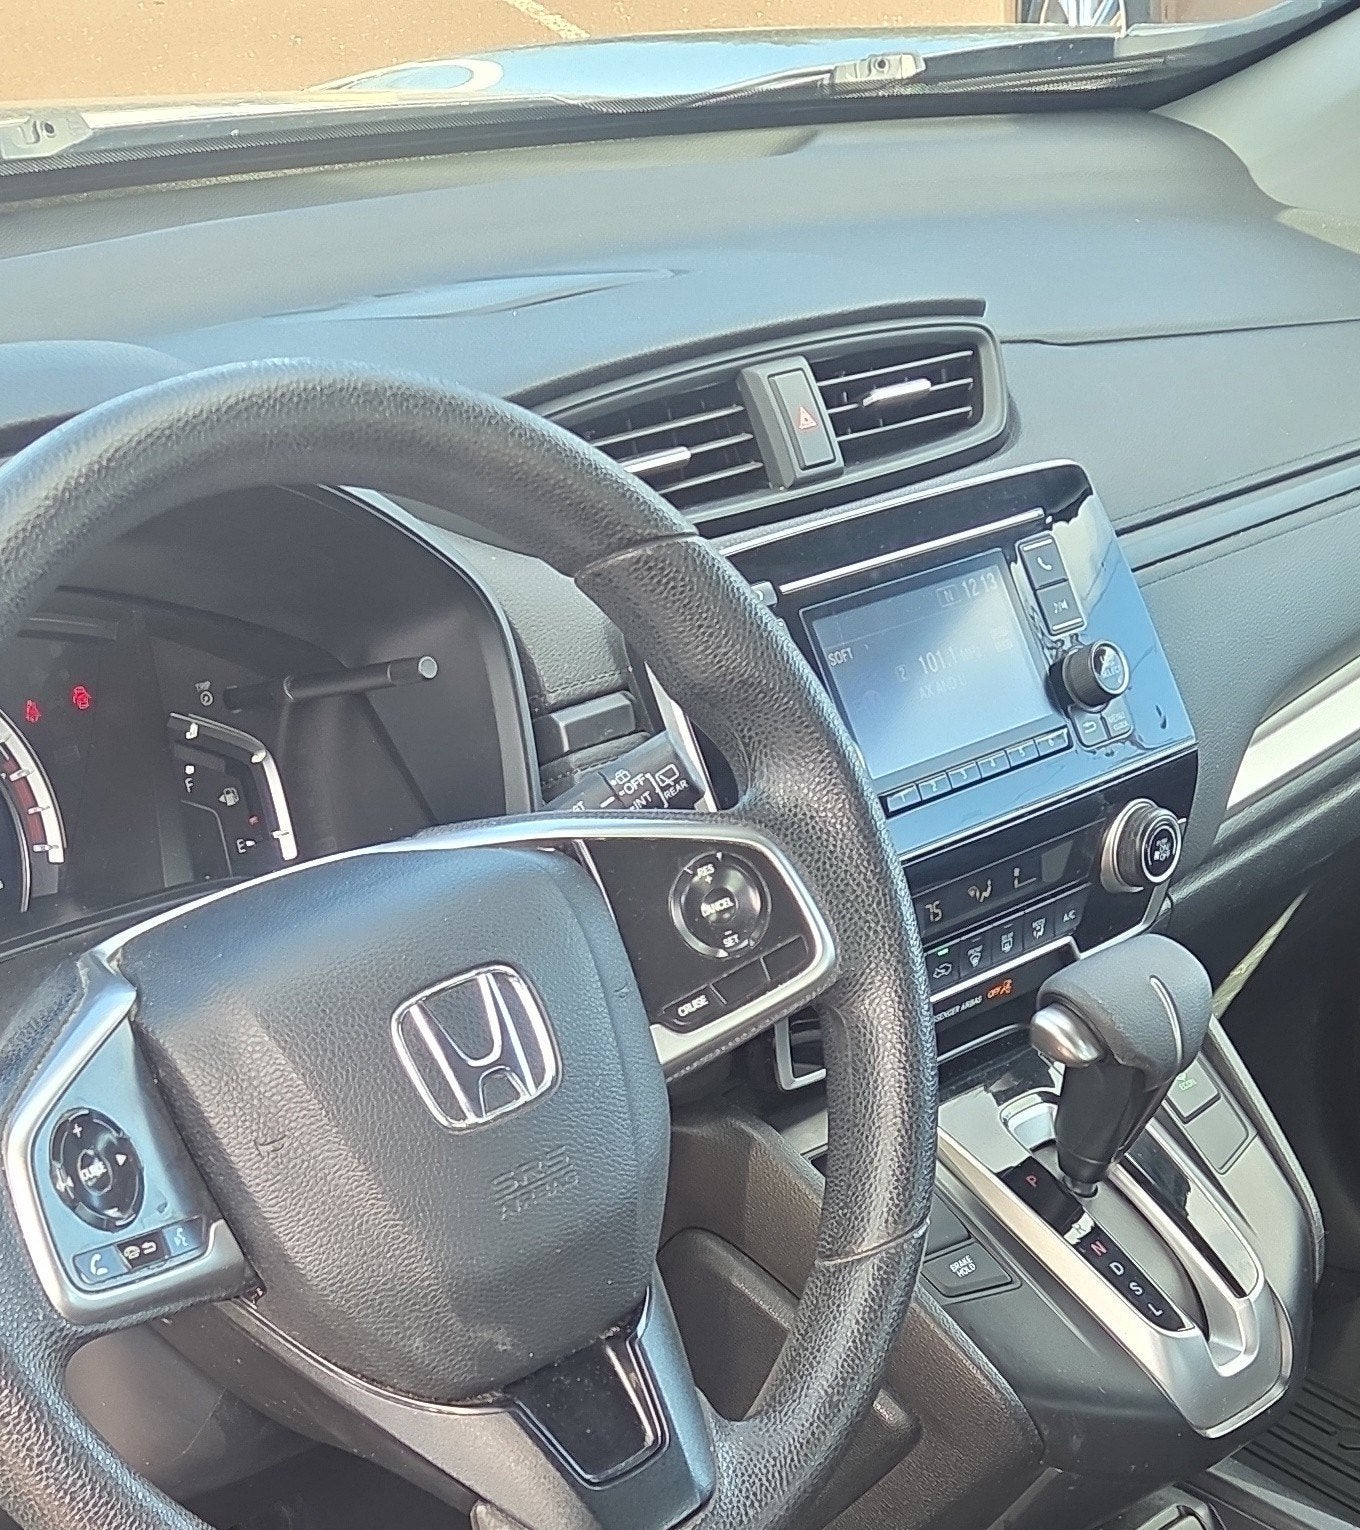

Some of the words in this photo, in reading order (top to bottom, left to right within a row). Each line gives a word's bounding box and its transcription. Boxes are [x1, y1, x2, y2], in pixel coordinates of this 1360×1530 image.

[827, 647, 854, 667] SOFT
[185, 777, 194, 793] F
[623, 772, 647, 795] OFF
[663, 779, 689, 800] REAR
[237, 838, 247, 854] E
[722, 934, 740, 948] SET
[678, 994, 710, 1017] CRUISE
[1025, 1174, 1038, 1188] P
[1090, 1240, 1107, 1257] N
[950, 1254, 973, 1273] BRAKE
[956, 1263, 976, 1278] HOLD
[1108, 1261, 1125, 1276] D
[1129, 1281, 1144, 1296] S
[1147, 1302, 1164, 1317] L
